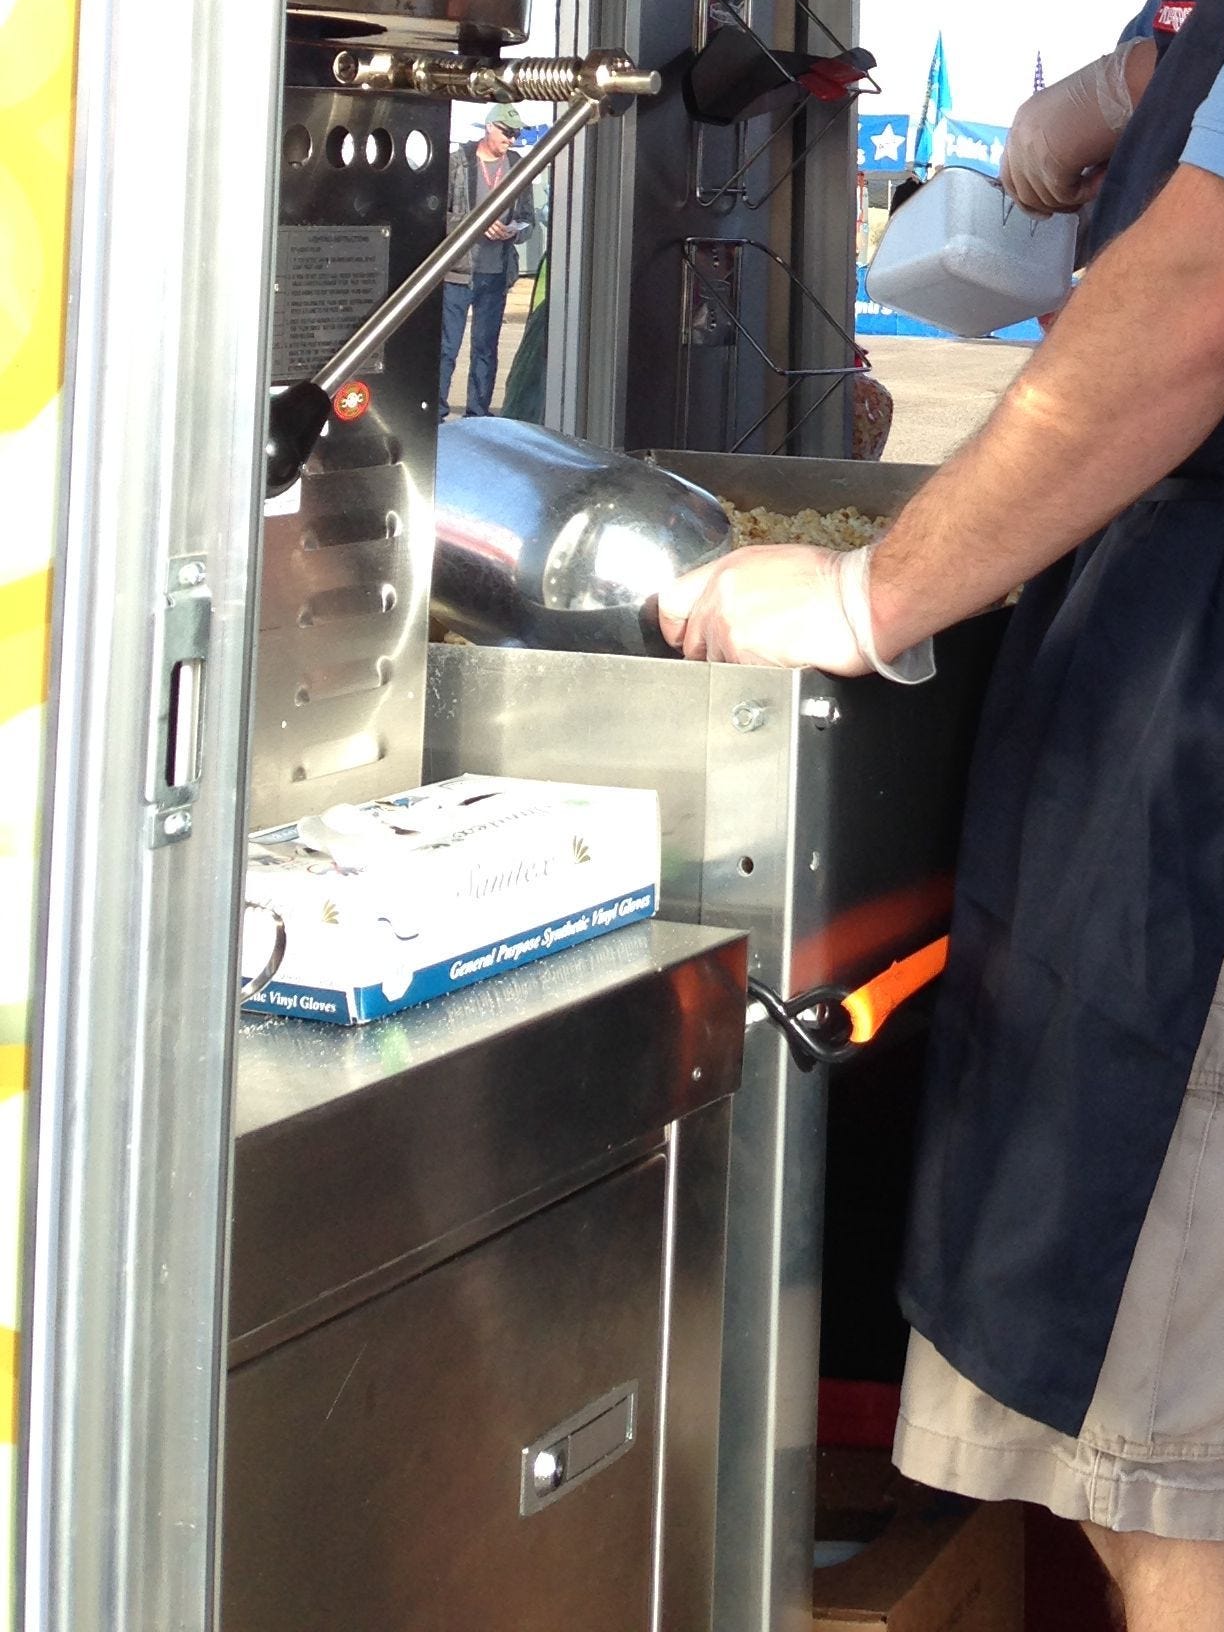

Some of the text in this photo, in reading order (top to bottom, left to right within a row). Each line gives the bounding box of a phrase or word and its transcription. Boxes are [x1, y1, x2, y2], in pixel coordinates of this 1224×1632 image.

[449, 894, 651, 980] General Purpose Synthetic Vinyl Gloves
[269, 991, 298, 1010] Vinyl
[299, 995, 337, 1013] Gloves
